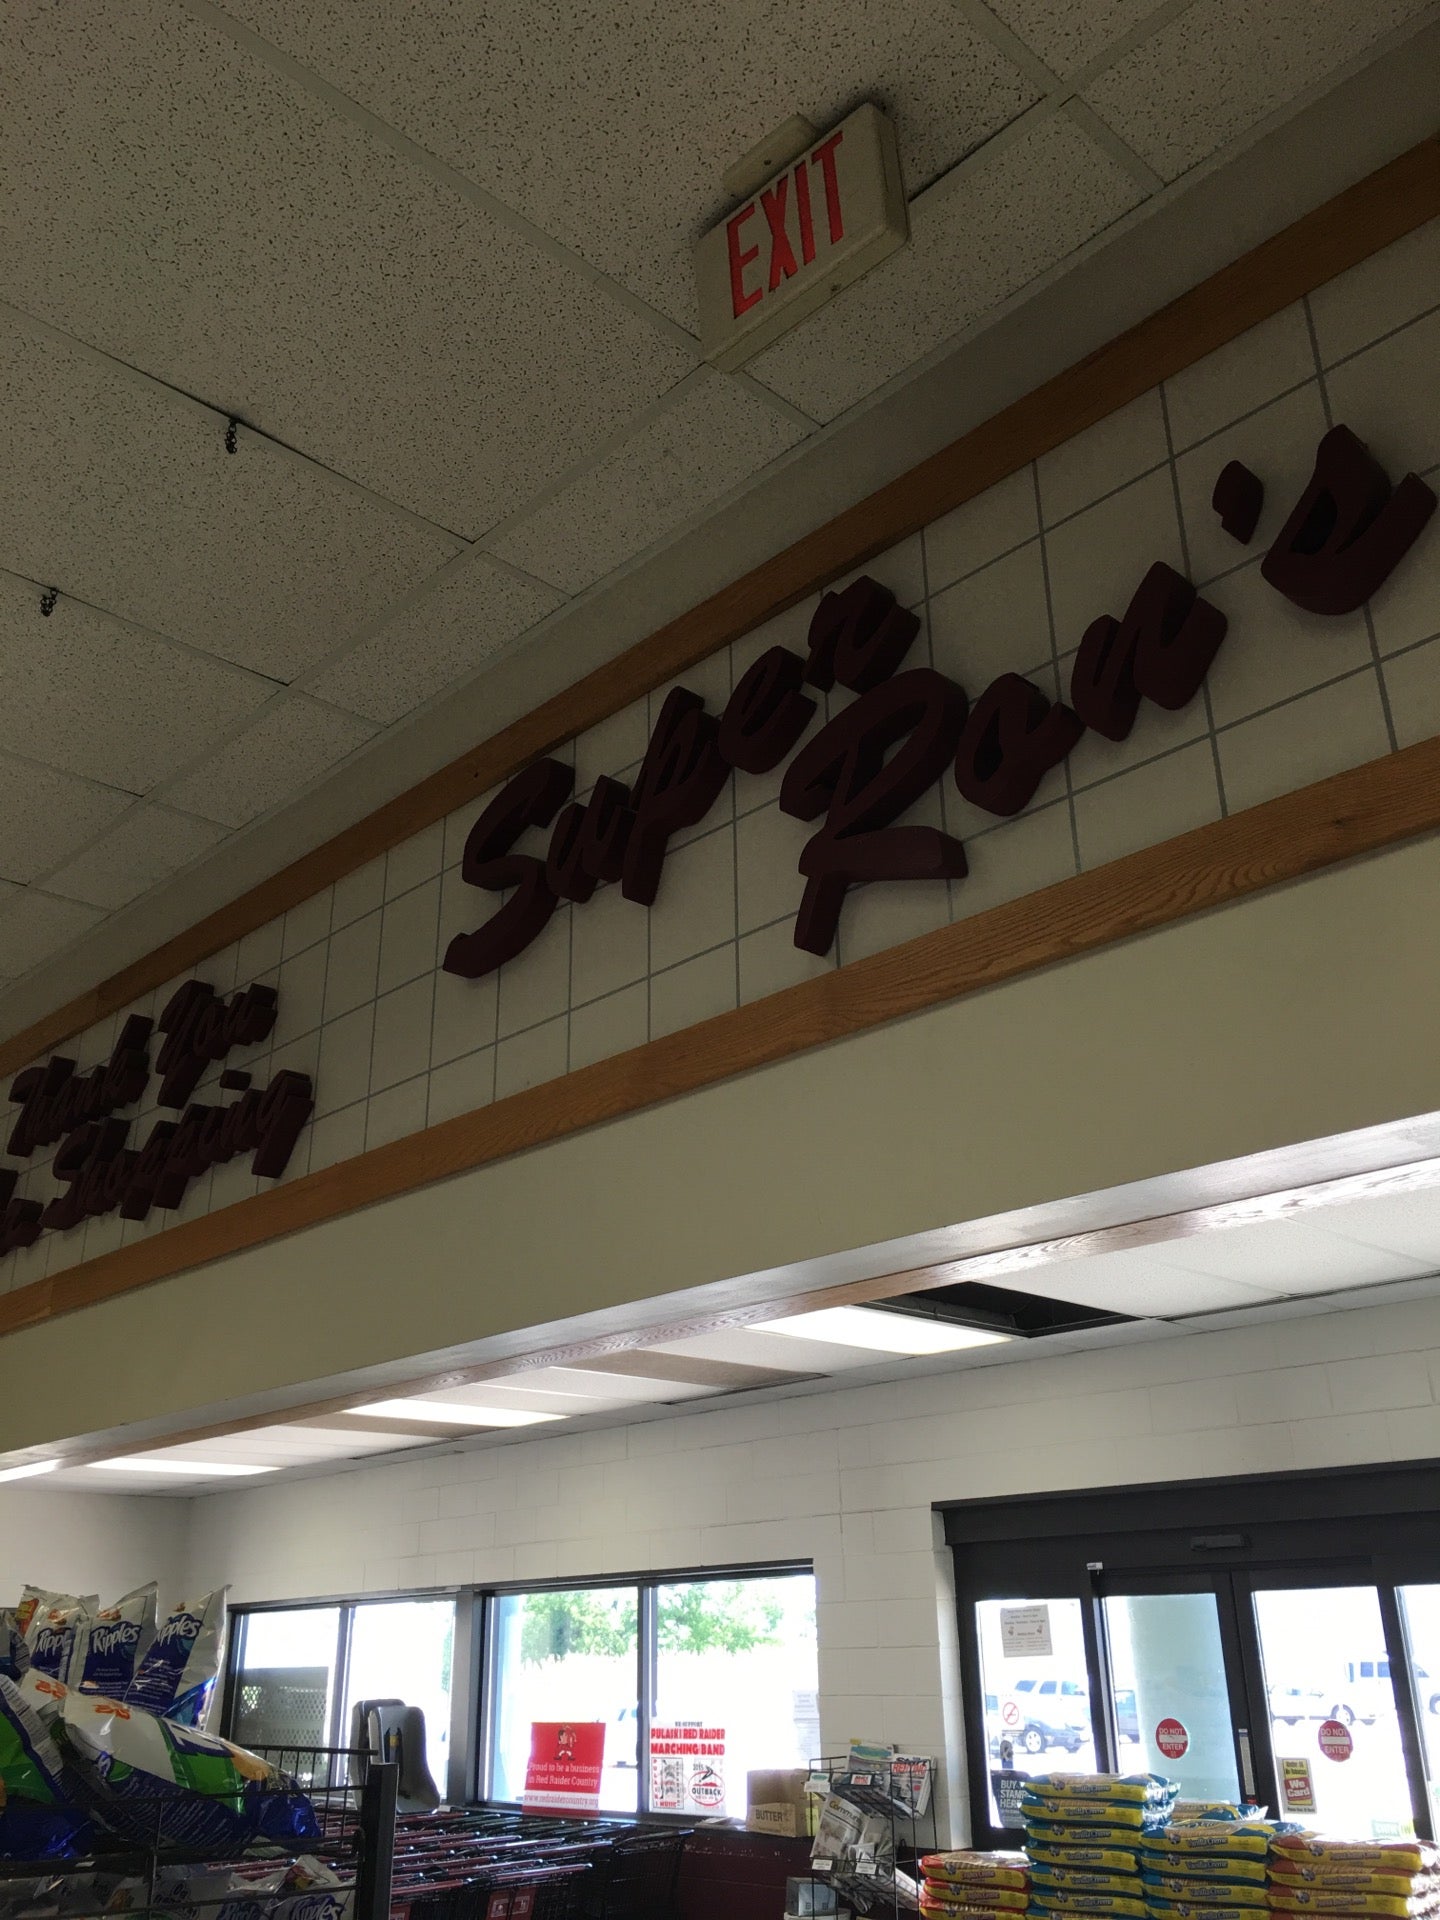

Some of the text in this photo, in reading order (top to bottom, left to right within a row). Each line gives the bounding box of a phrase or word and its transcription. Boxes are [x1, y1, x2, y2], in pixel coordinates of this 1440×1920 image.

[726, 130, 844, 320] EXIT
[780, 424, 1437, 956] Ron's
[442, 575, 920, 978] Super
[7, 979, 278, 1157] Thank You
[42, 1069, 315, 1230] Shopping
[91, 1622, 141, 1657] Ripples
[651, 1728, 725, 1740] PULASKI RED RAIDER
[1159, 1727, 1169, 1735] DO
[1320, 1727, 1347, 1737] DO NOT
[651, 1743, 725, 1755] MARCHING BAND
[1162, 1743, 1184, 1751] ENTER
[1324, 1746, 1349, 1754] ENTER
[529, 1762, 547, 1772] Proud
[549, 1763, 555, 1771] to
[556, 1763, 563, 1772] be
[570, 1764, 599, 1773] business
[528, 1774, 598, 1788] in Red Raider Country
[1000, 1779, 1017, 1789] BUY
[1288, 1779, 1305, 1789] We
[692, 1787, 722, 1796] OUTBACK
[1000, 1790, 1028, 1799] STAMP
[1287, 1786, 1310, 1797] Card
[1000, 1799, 1020, 1808] HER
[755, 1808, 783, 1822] BUTTER
[1187, 1839, 1207, 1847] Vanilla
